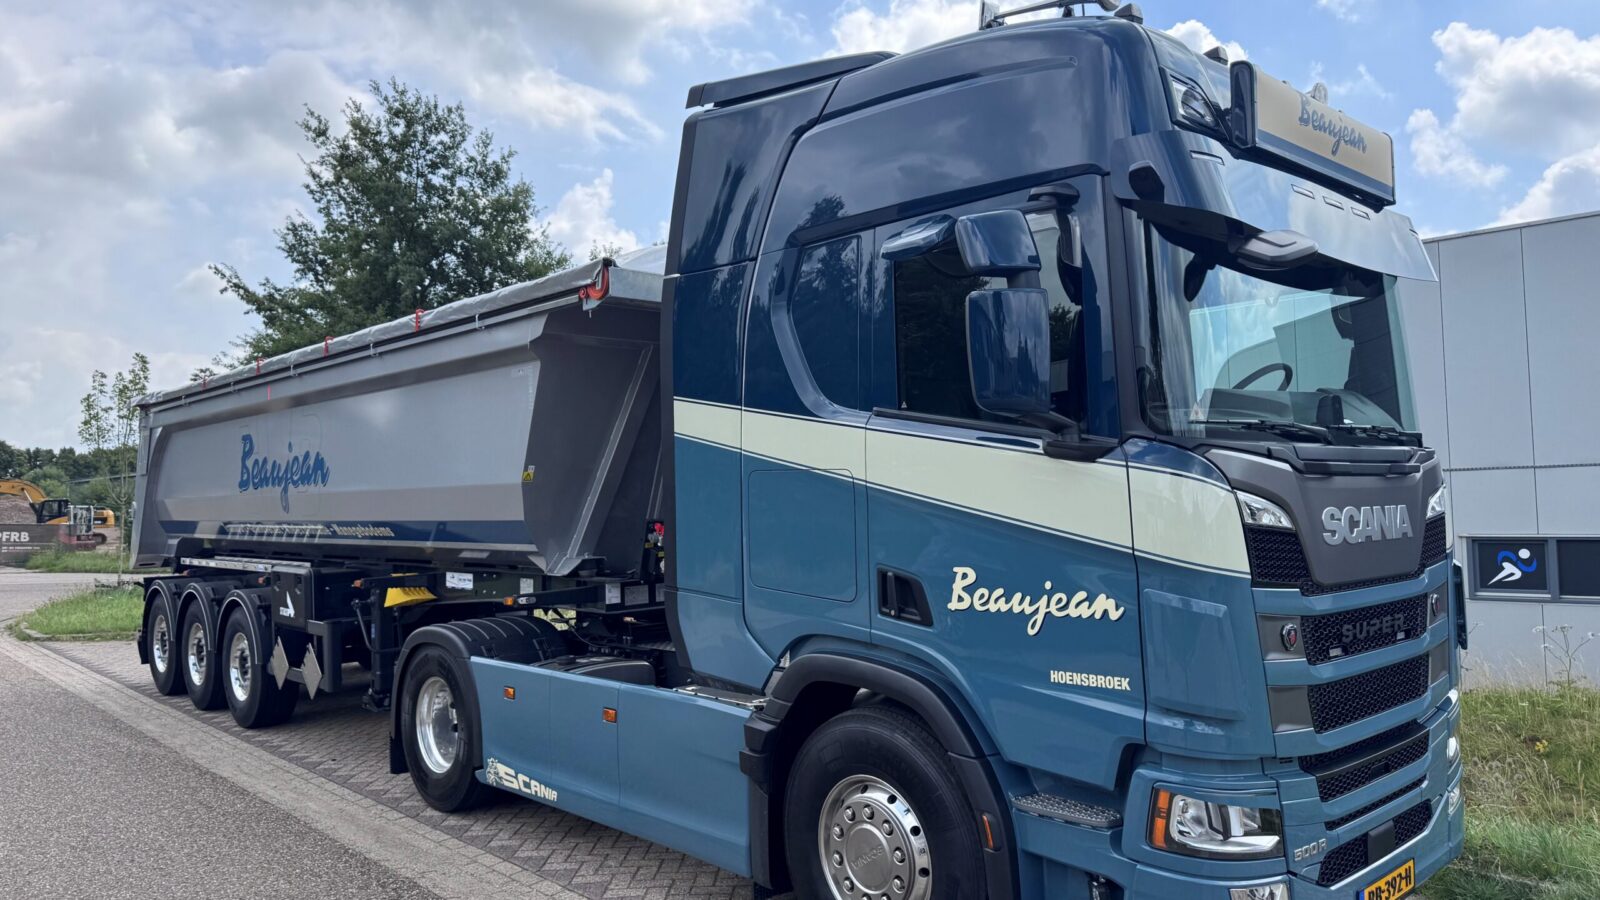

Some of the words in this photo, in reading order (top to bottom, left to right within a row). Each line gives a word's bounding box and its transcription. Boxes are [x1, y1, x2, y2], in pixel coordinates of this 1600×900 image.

[1298, 97, 1368, 156] Beaujean
[238, 433, 330, 514] Beaujean
[0, 531, 30, 542] FRB
[1322, 504, 1413, 546] SCANIA
[947, 566, 1125, 636] Beaujean
[1341, 613, 1404, 643] SUPER
[1049, 670, 1131, 691] HOENSBROEK
[496, 763, 558, 801] SCANIA
